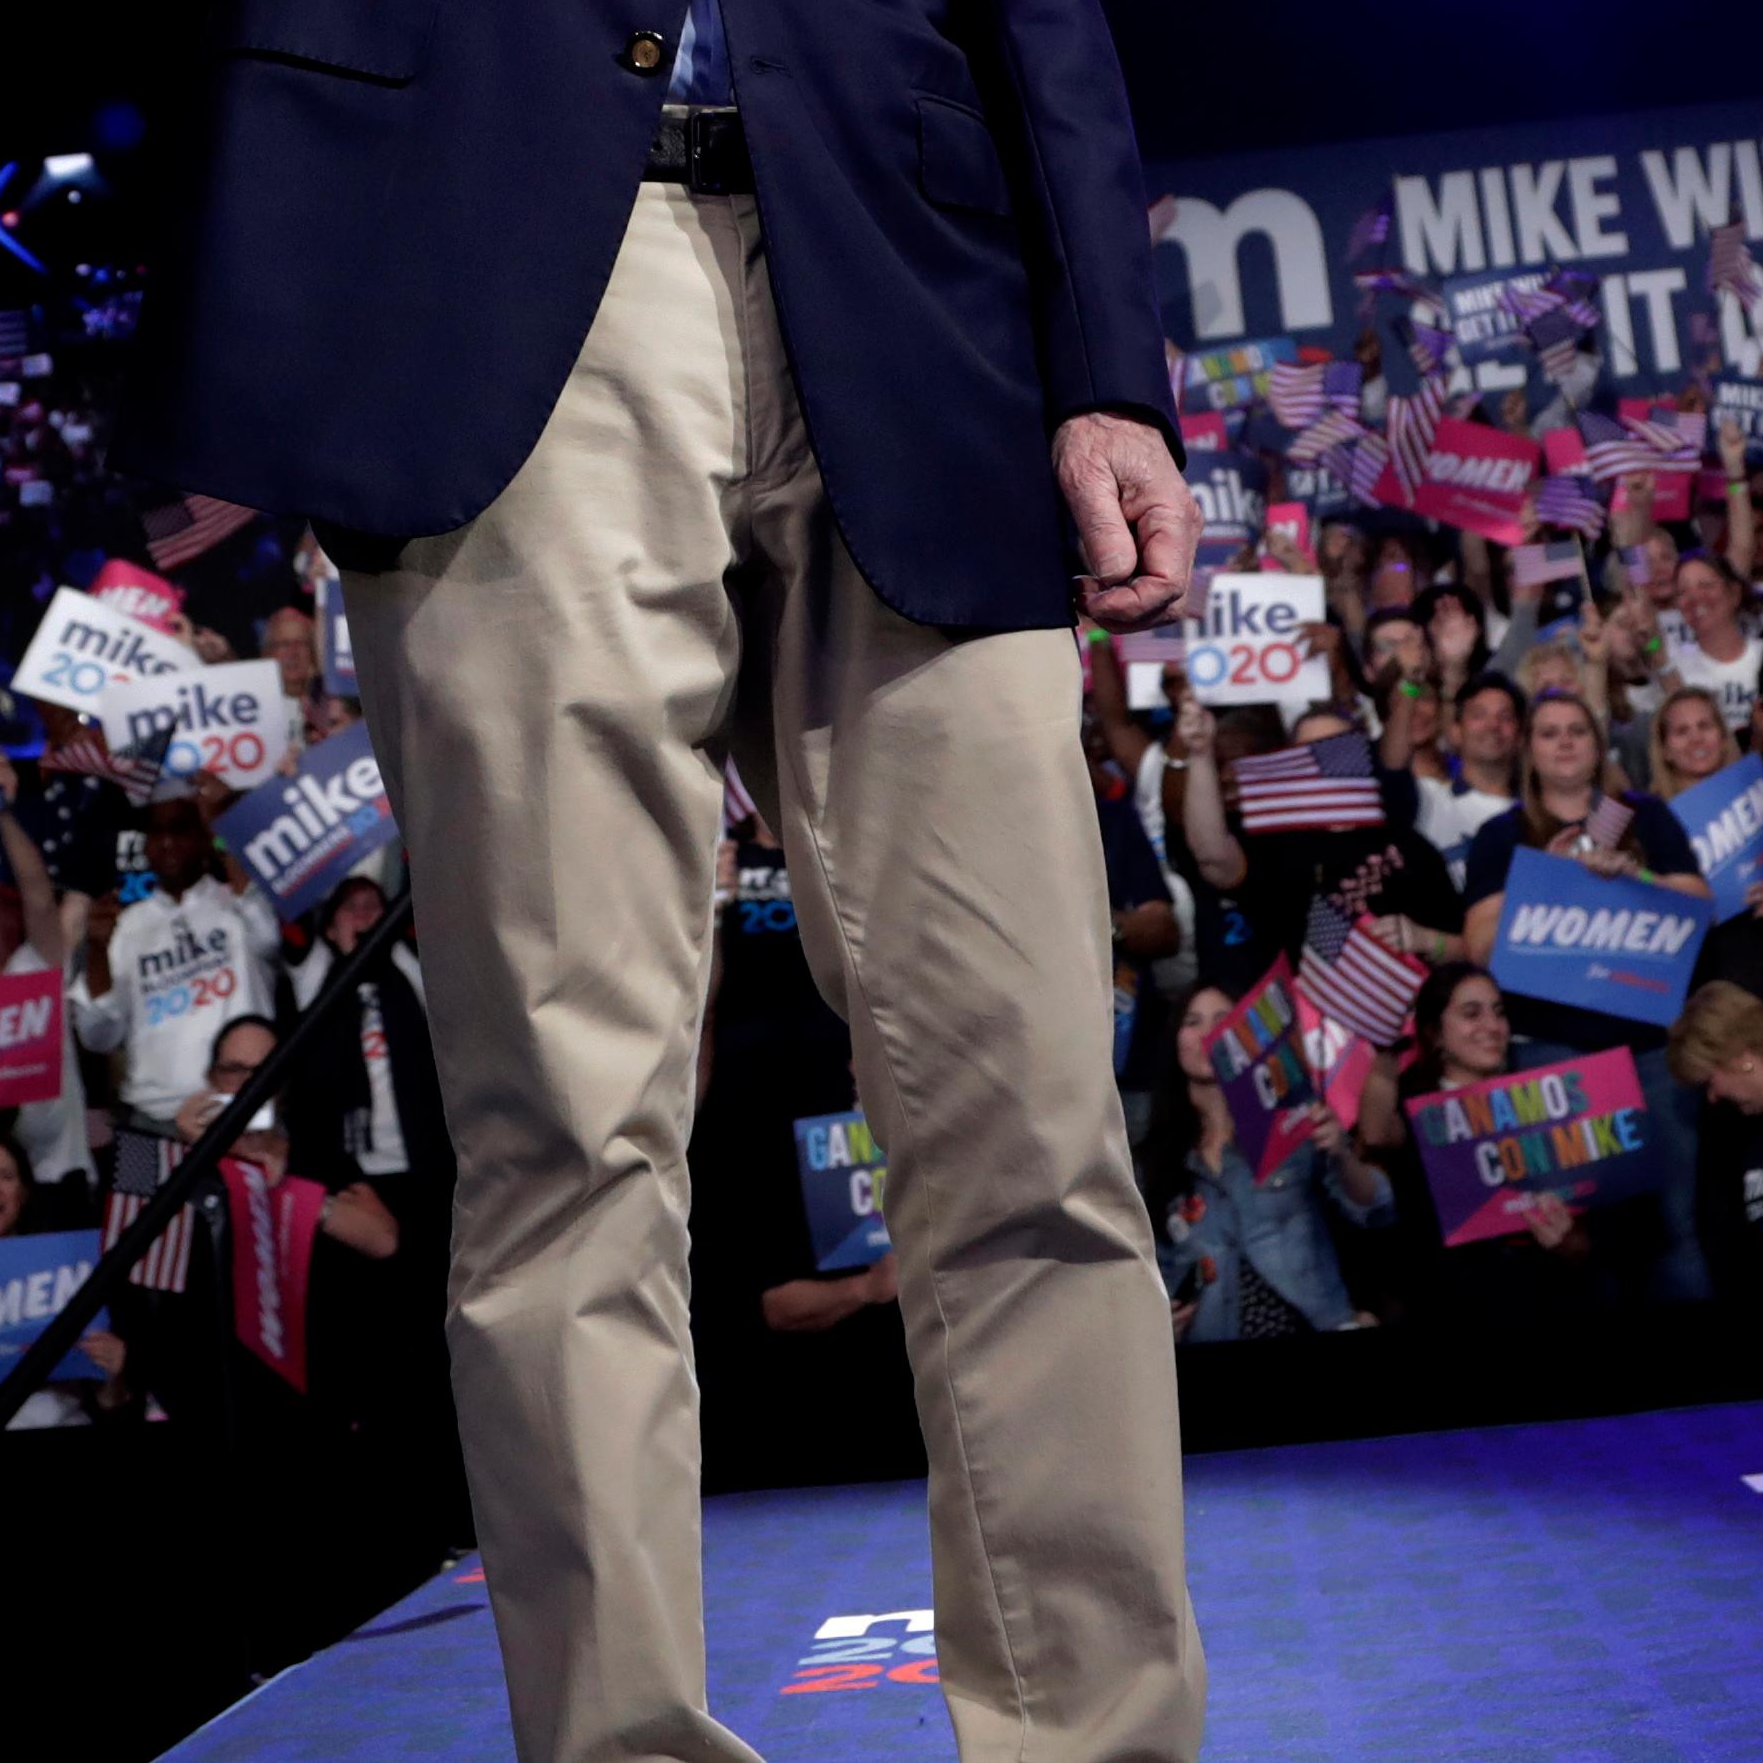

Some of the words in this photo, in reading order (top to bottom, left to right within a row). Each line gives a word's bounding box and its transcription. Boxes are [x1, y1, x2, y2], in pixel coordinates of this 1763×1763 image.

[1392, 155, 1629, 276] MIKE
[1601, 267, 1687, 378] IT
[1429, 448, 1533, 494] OMEN
[1192, 589, 1298, 637] ike
[1188, 642, 1302, 687] 020
[243, 756, 386, 880] mike
[140, 919, 228, 978] mike
[1508, 903, 1696, 955] WOMEN
[1418, 1070, 1591, 1148] GANAMOS
[1473, 1132, 1551, 1188] CON
[1551, 1106, 1646, 1172] MIKE
